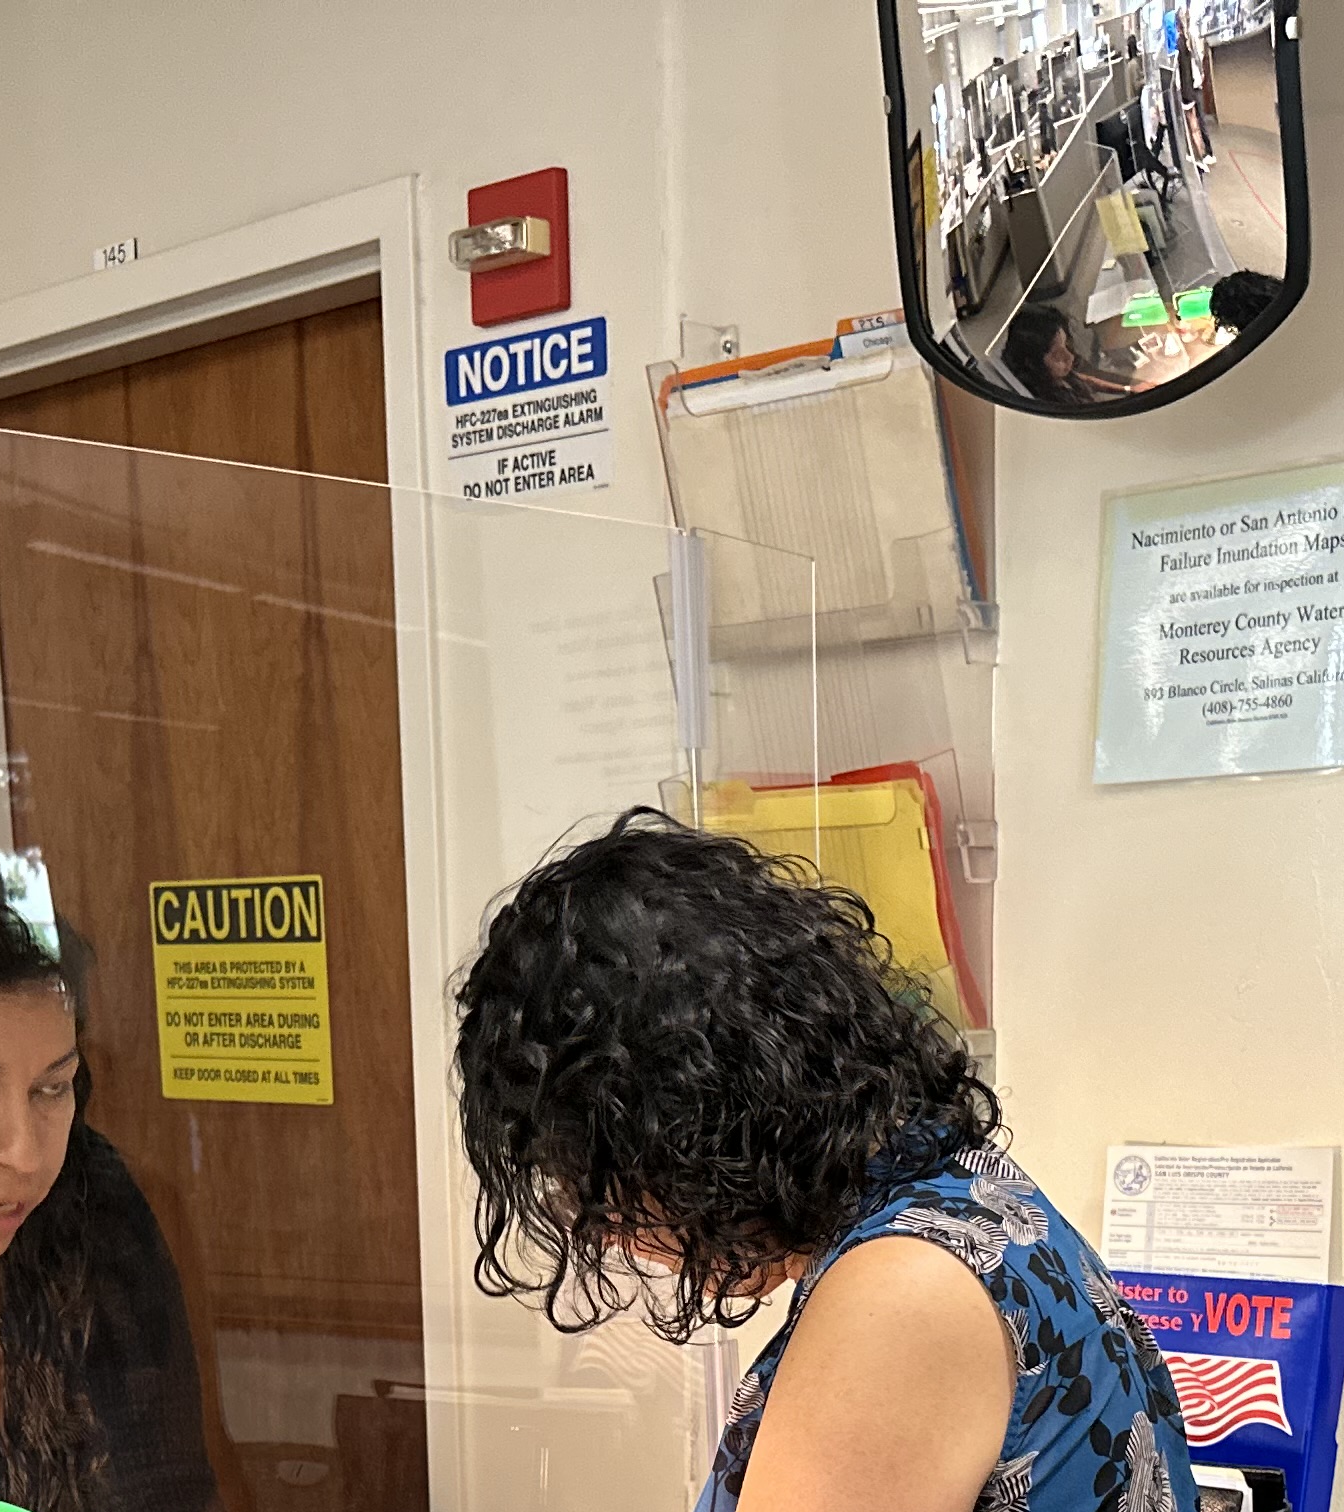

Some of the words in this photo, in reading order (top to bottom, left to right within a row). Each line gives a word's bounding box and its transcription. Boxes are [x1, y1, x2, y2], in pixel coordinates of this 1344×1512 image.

[458, 326, 595, 397] NOTICE
[512, 389, 598, 419] EXTINGUISHING
[451, 428, 494, 449] SYSTEM
[497, 415, 559, 441] DISCHARGE
[563, 406, 604, 428] ALARM
[498, 458, 509, 475] IF
[512, 450, 557, 472] ACTIVE
[464, 483, 482, 500] DO
[485, 478, 510, 498] NOT
[514, 471, 555, 494] ENTER
[559, 464, 595, 484] AREA
[1131, 523, 1216, 550] Nacimiento
[1220, 520, 1237, 536] or
[1240, 514, 1269, 534] San
[1274, 504, 1338, 528] Antonio
[1160, 549, 1212, 573] Failure
[1217, 540, 1299, 565] Inundation
[1190, 583, 1241, 603] available
[1244, 579, 1261, 594] for
[1263, 572, 1324, 593] inspection
[1327, 570, 1340, 584] at
[1159, 617, 1231, 641] Monterey
[1235, 610, 1292, 632] County
[1179, 641, 1256, 666] Resources
[1260, 634, 1322, 658] Agency
[1168, 682, 1207, 699] Blanco
[1210, 678, 1248, 695] Circle,
[1251, 675, 1293, 691] Salinas
[157, 886, 319, 941] CAUTION
[173, 961, 193, 975] THIS
[195, 961, 217, 975] AREA
[219, 961, 228, 974] IS
[230, 961, 282, 975] PROTECTED
[285, 960, 297, 974] BY
[298, 959, 306, 973] A
[211, 977, 277, 990] EXTINGUISHING
[279, 977, 315, 990] SYSTEM
[166, 1012, 181, 1027] DO
[184, 1012, 205, 1028] NOT
[208, 1013, 243, 1028] ENTER
[246, 1013, 275, 1029] AREA
[278, 1013, 320, 1029] DURING
[185, 1032, 201, 1047] OR
[203, 1032, 236, 1048] AFTER
[240, 1032, 302, 1050] DISCHARGE
[173, 1068, 196, 1081] KEEP
[197, 1069, 222, 1082] DOOR
[224, 1069, 259, 1083] CLOSED
[261, 1069, 271, 1083] AT
[274, 1070, 291, 1084] ALL
[293, 1070, 321, 1086] TIMES
[1116, 1280, 1163, 1301] ister
[1168, 1286, 1189, 1304] to
[1190, 1312, 1203, 1333] Y
[1204, 1292, 1293, 1340] VOTE
